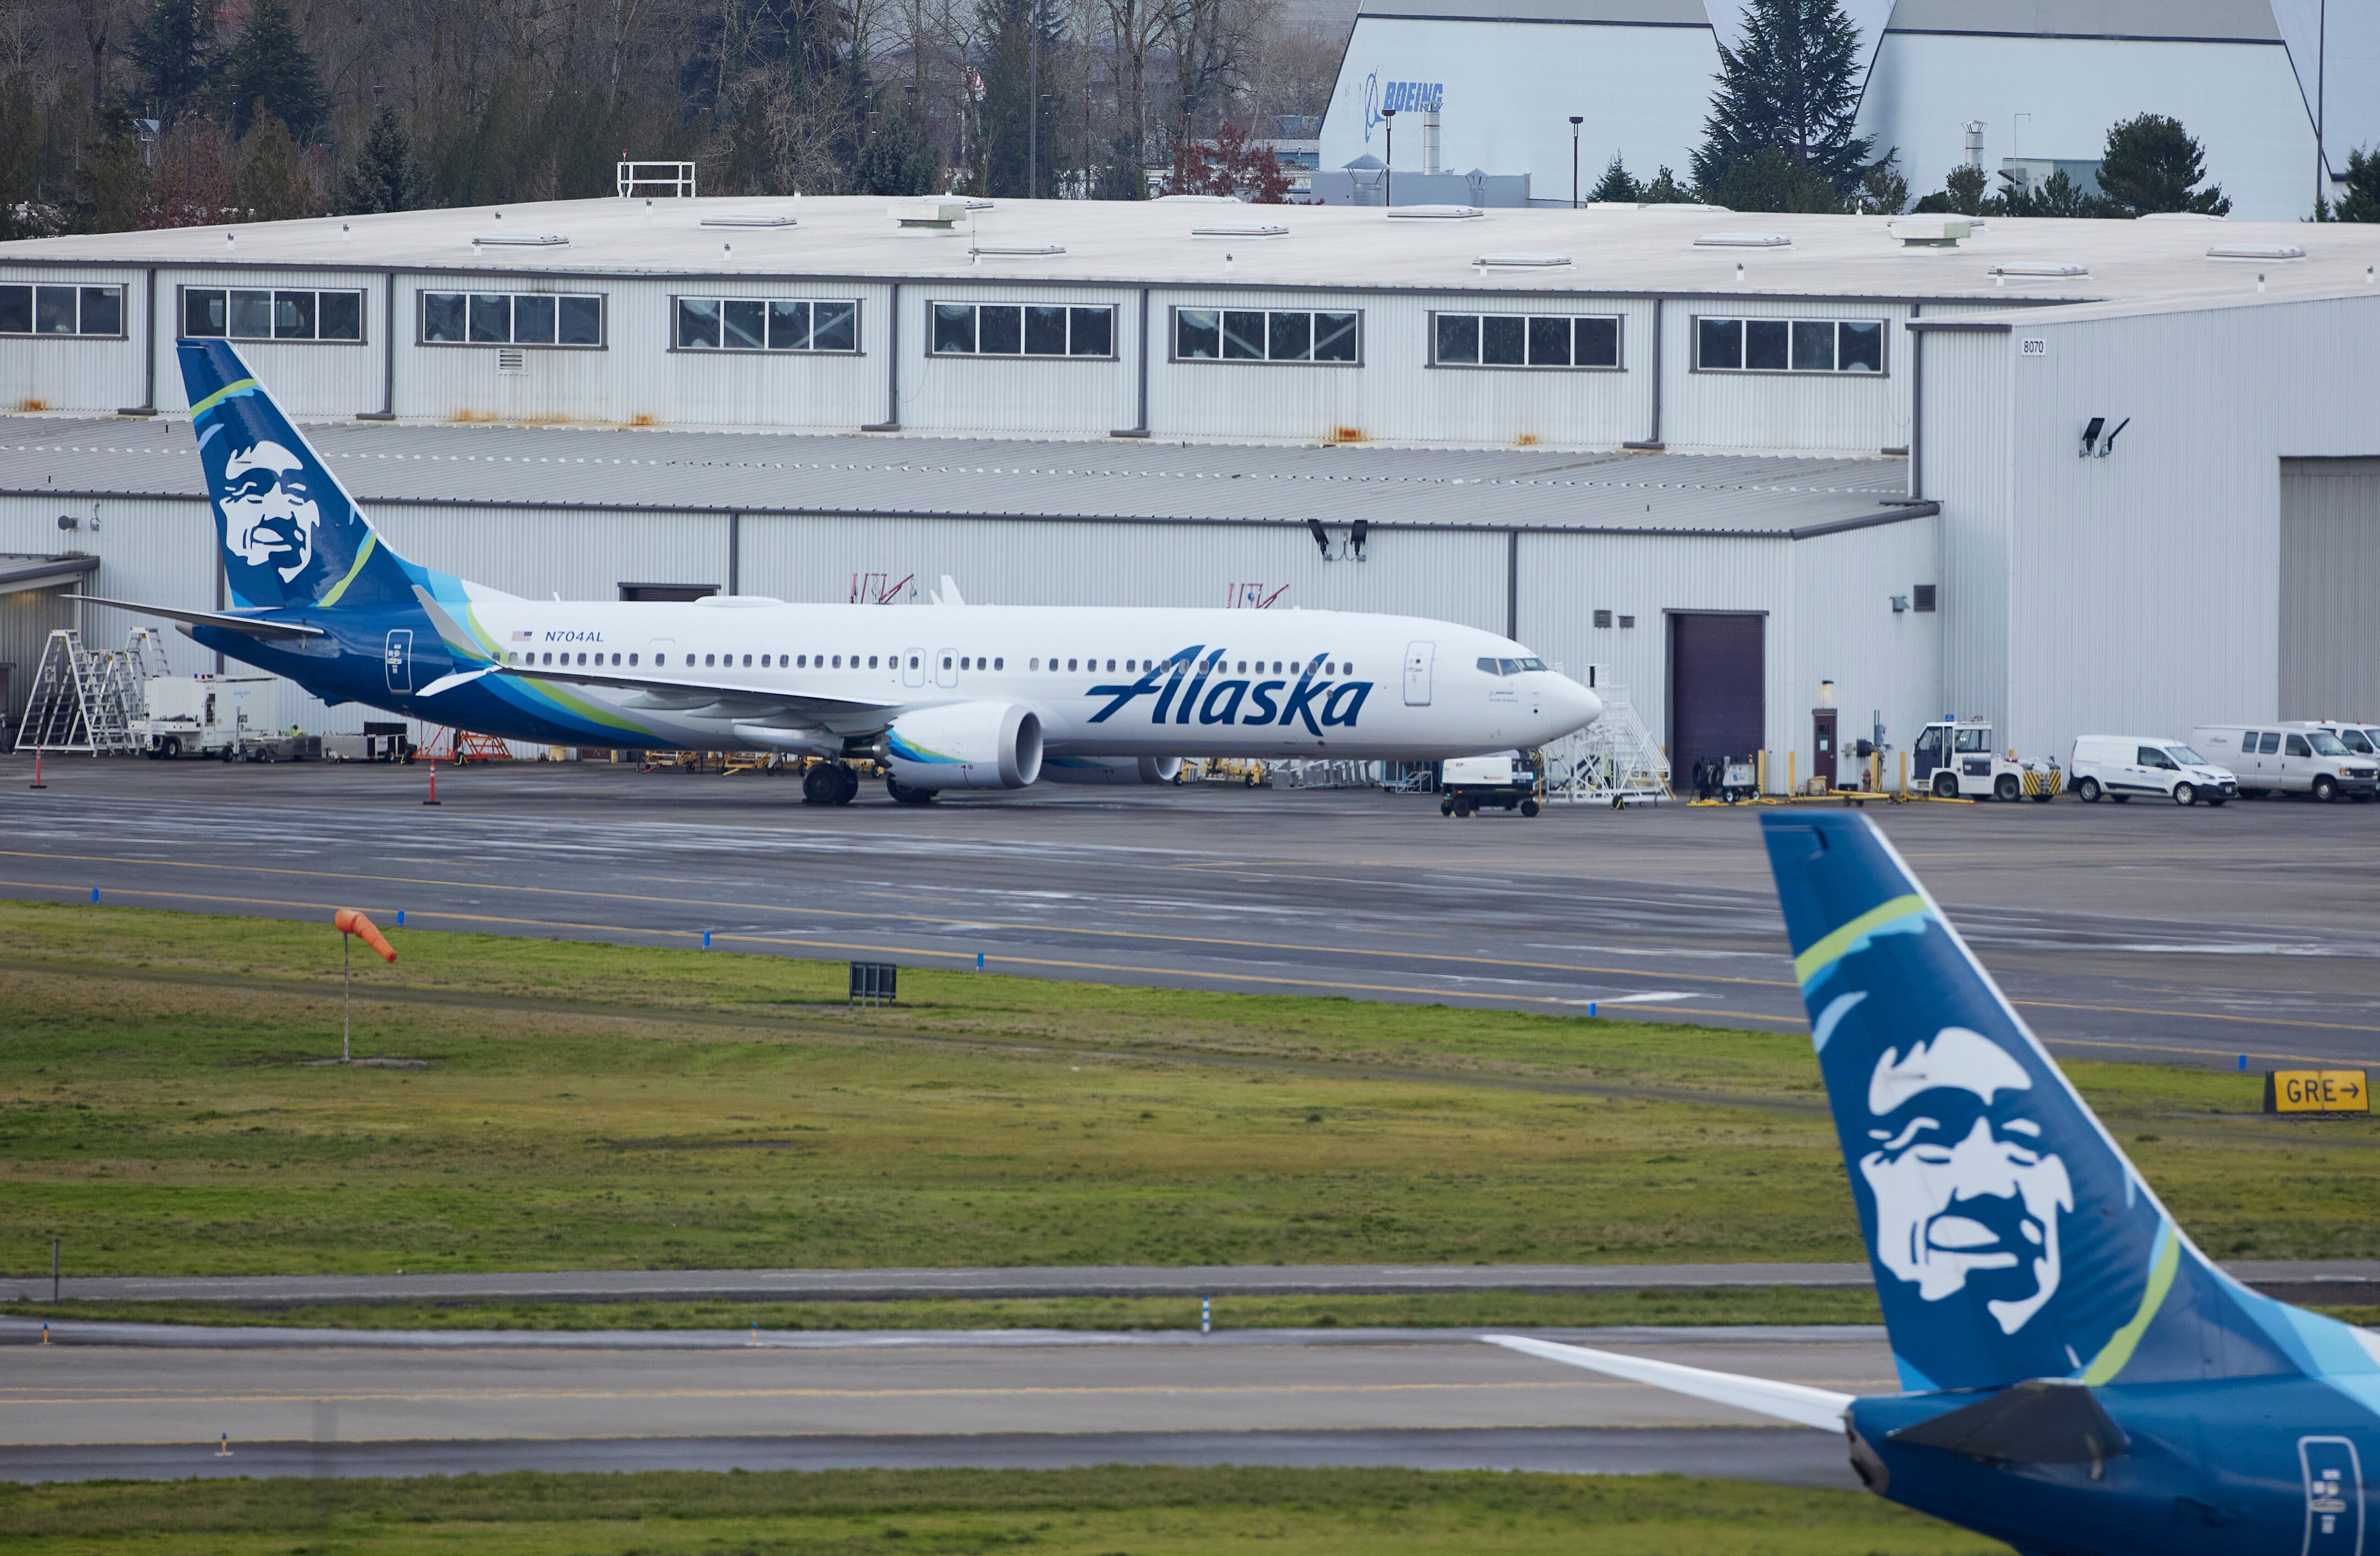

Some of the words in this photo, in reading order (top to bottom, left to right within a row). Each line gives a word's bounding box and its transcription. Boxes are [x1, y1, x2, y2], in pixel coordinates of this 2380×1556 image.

[1384, 82, 1443, 112] BOEING
[2024, 341, 2043, 353] 8070
[545, 631, 604, 642] N704AL
[1085, 645, 1374, 736] Alaska
[2287, 1079, 2336, 1103] GRE
